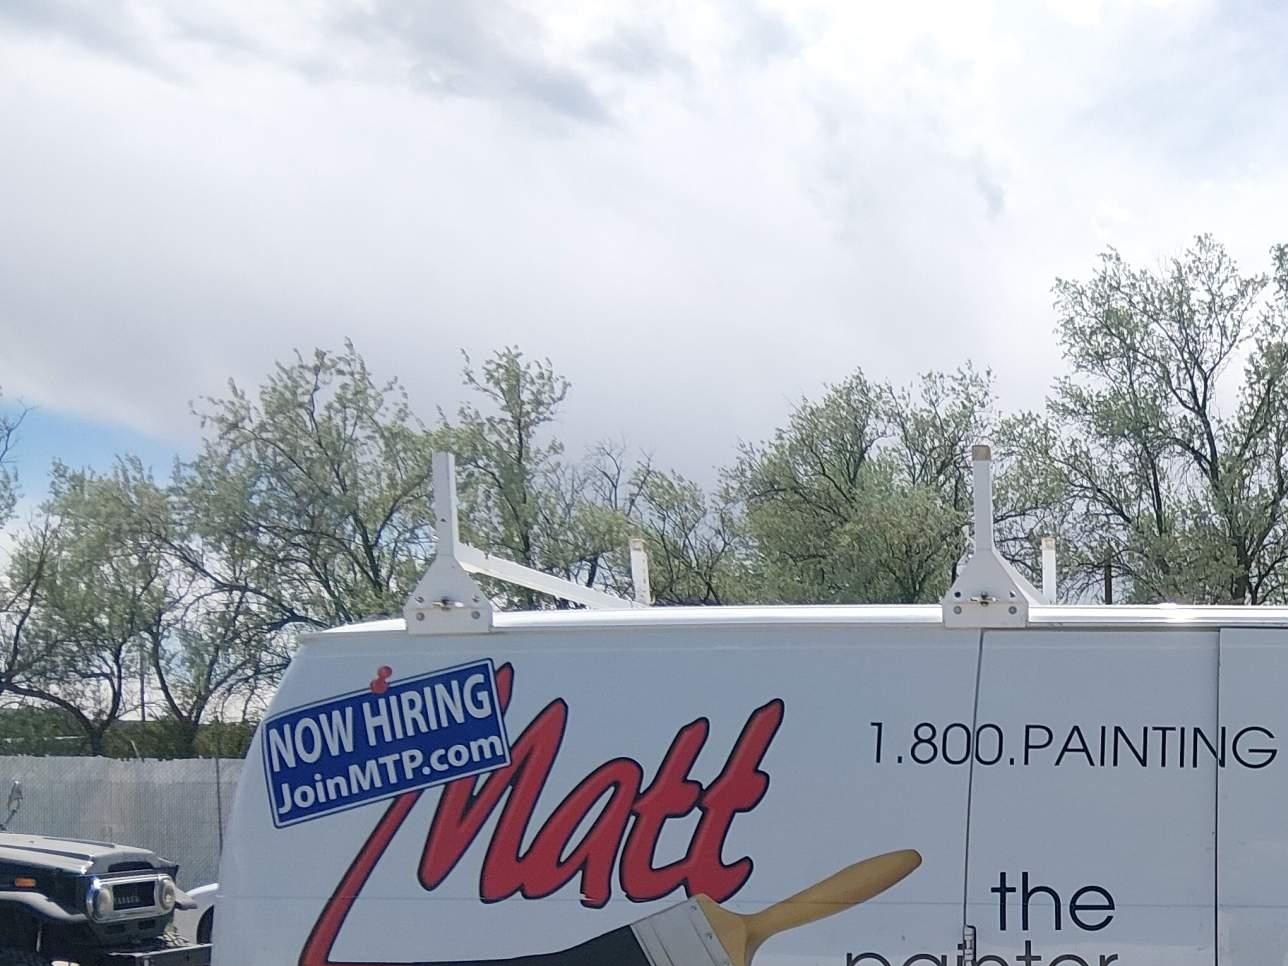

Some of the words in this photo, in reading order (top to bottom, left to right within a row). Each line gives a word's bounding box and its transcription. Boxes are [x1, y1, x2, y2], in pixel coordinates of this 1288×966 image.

[268, 706, 354, 772] NOW
[362, 673, 492, 747] HIRING
[870, 721, 1278, 769] 1.800.PAINTING
[278, 734, 504, 814] JoinMTP.com
[298, 662, 785, 908] Matt
[990, 871, 1116, 931] the
